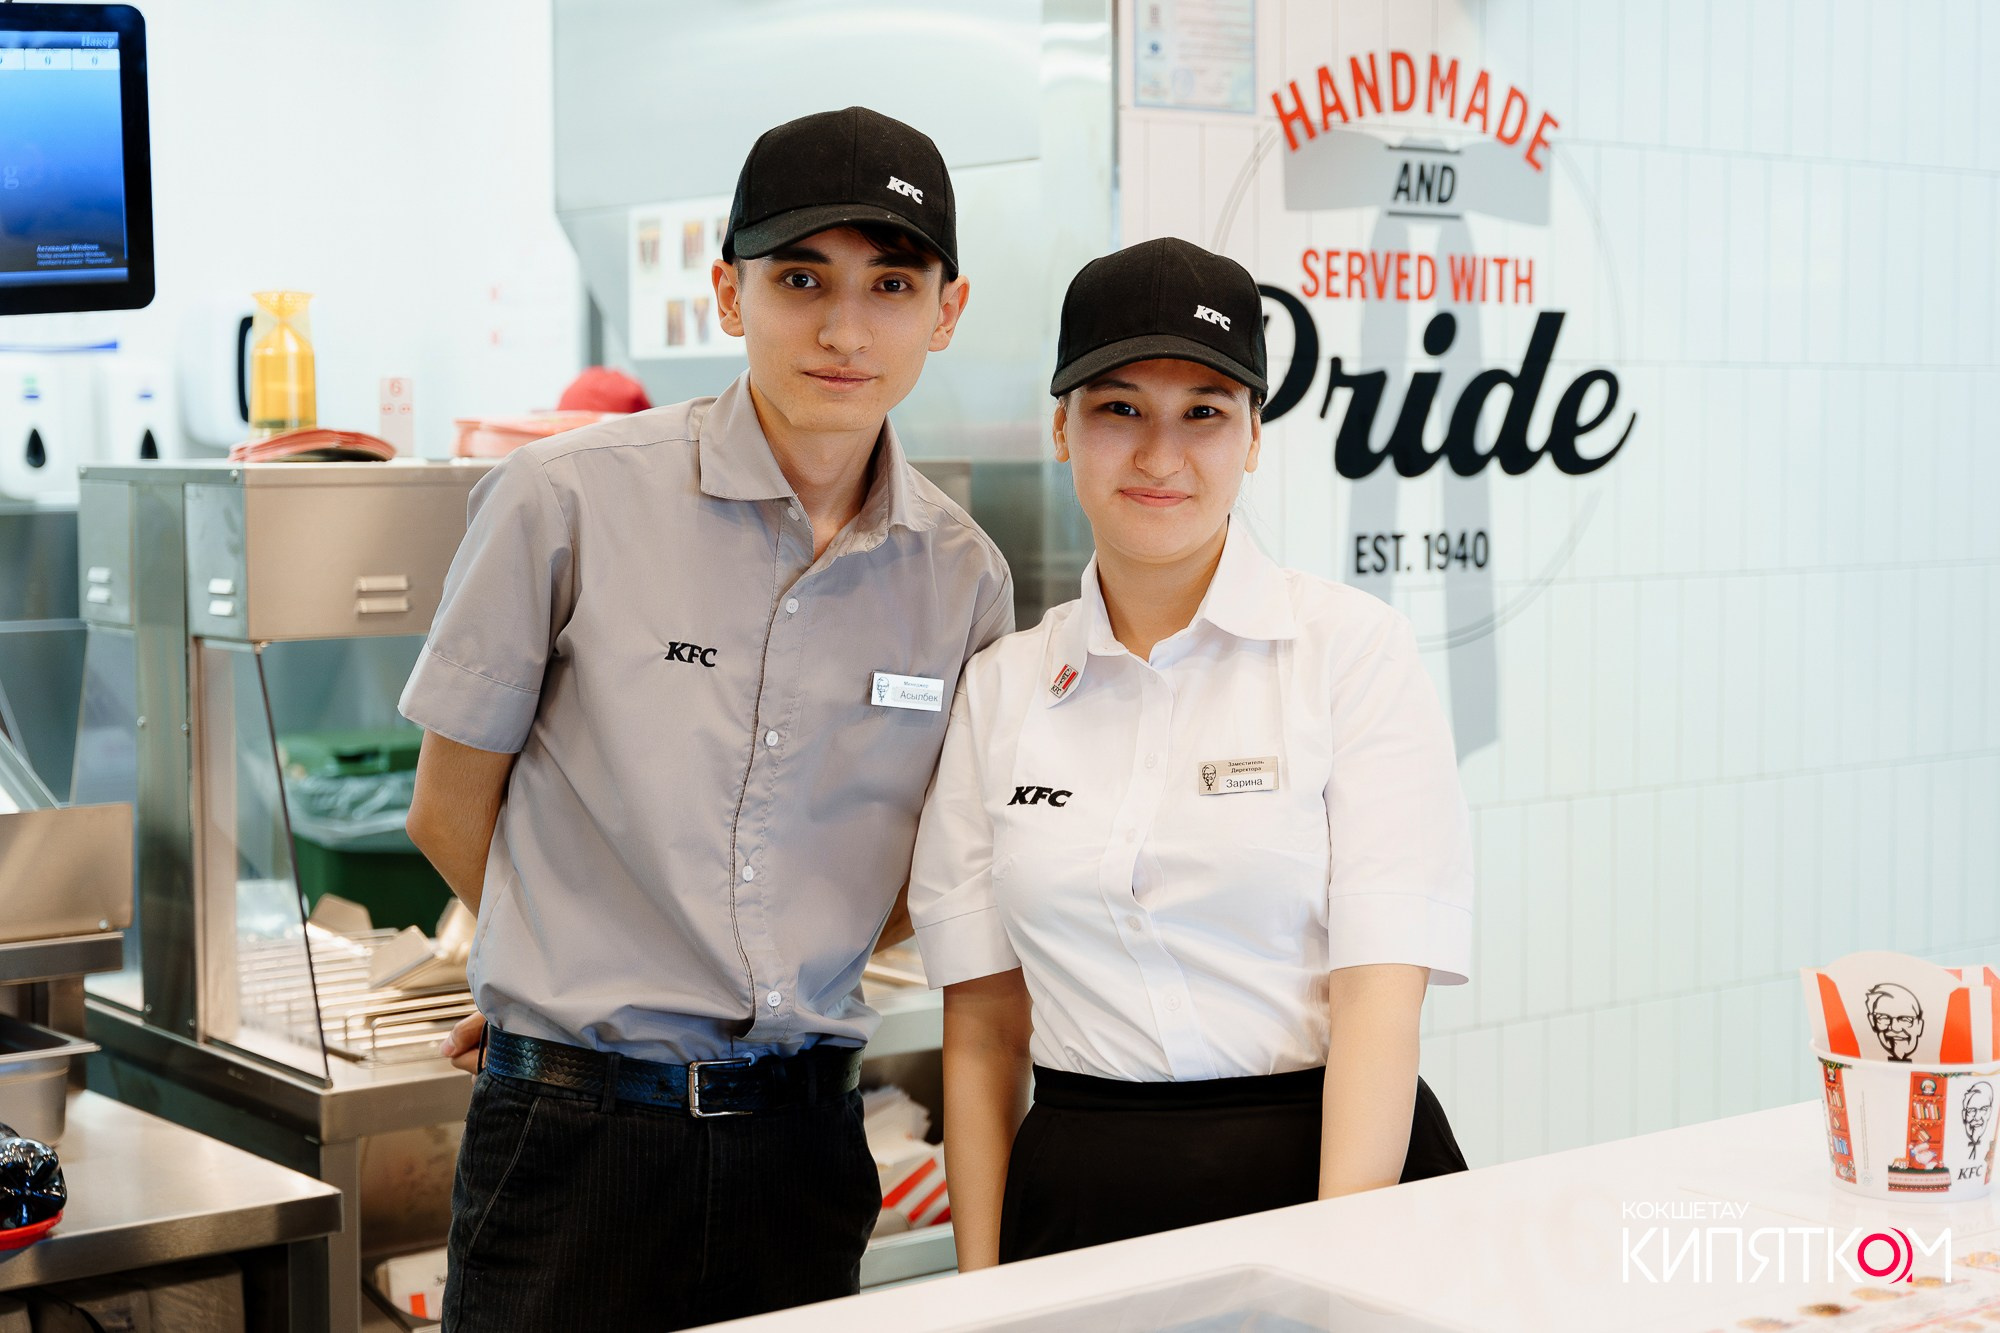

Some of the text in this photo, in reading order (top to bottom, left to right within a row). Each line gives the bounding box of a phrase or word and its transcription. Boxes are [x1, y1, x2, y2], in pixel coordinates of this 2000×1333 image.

[1271, 51, 1560, 173] HANDMADE
[886, 175, 924, 205] KFC
[1393, 160, 1456, 203] AND
[1301, 249, 1534, 303] SERVED WITH
[1193, 304, 1231, 332] KFC
[1355, 532, 1489, 574] EST. 1940
[664, 641, 718, 668] KFC
[900, 690, 939, 702] Асылбек
[1007, 786, 1073, 808] KFC
[1226, 778, 1263, 788] Зарина
[1957, 1165, 1983, 1181] KFC
